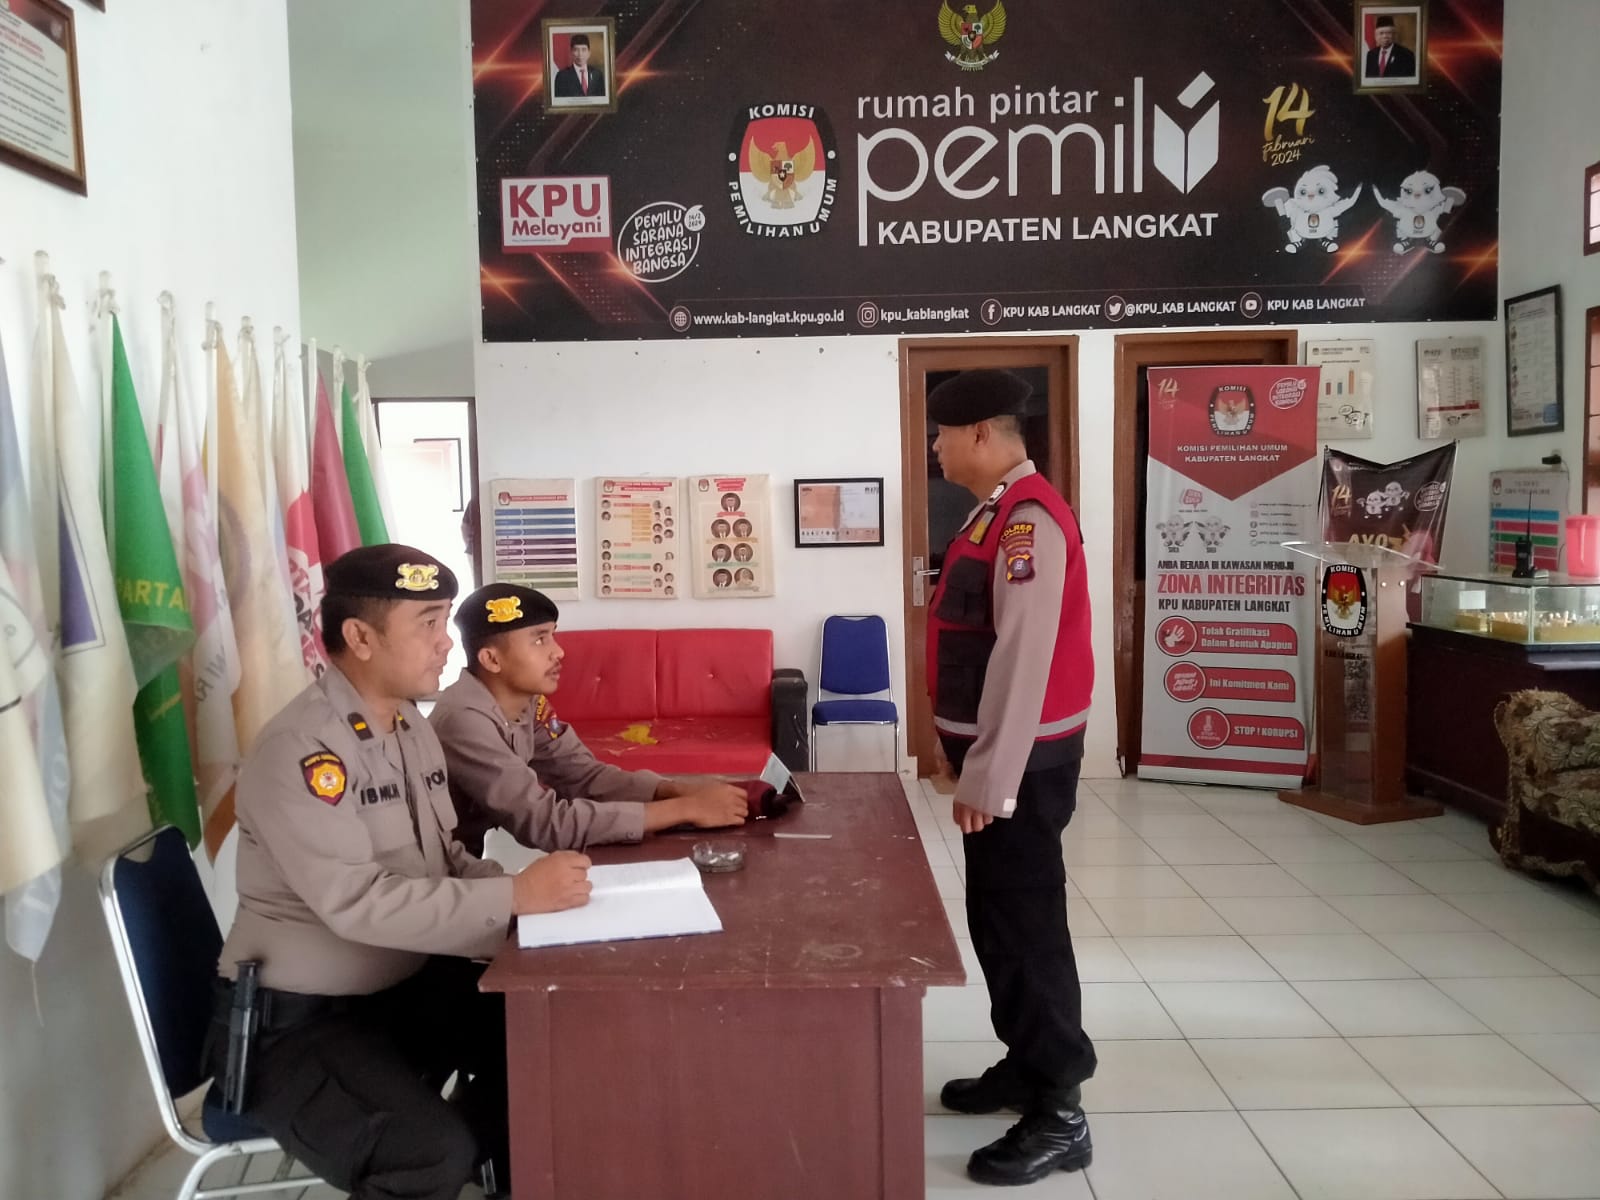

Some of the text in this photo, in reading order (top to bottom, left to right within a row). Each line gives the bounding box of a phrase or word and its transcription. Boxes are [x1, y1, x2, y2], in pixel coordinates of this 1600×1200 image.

[749, 104, 815, 120] KOMISI
[857, 85, 1099, 124] rumah pintar
[1262, 83, 1316, 141] 14
[1271, 149, 1301, 167] 2024
[509, 184, 601, 218] KPU
[728, 179, 838, 237] PEMILIHAN UMUM
[512, 216, 602, 240] Melayani
[634, 209, 682, 231] PEMILU
[633, 222, 684, 245] SARANA
[878, 213, 1219, 245] KABUPATEN LANGKAT
[625, 236, 692, 262] INTEGRASI
[633, 252, 686, 275] BANGSA
[1003, 304, 1101, 318] KPU KAB LANGKAT
[1124, 301, 1237, 316] @KPU_KAB LANGKAT
[1267, 298, 1366, 311] KPU KAB LANGKAT
[693, 309, 845, 326] www.kab-langkat.kpu.go.id
[880, 307, 970, 323] kpu_kablangkat
[1210, 444, 1258, 452] PEMILIHAN
[1239, 454, 1280, 462] LANGKAT
[1221, 560, 1261, 570] KAWASAN
[1330, 565, 1357, 574] KOMISI
[1157, 574, 1305, 596] ZONA INTEGRITAS
[1158, 599, 1291, 612] KPU KABUPATEN LANGKAT
[1201, 626, 1224, 635] Tolak
[1210, 679, 1221, 687] Ini
[1222, 679, 1266, 689] Komitmen
[1234, 726, 1255, 735] STOP
[1261, 727, 1298, 738] KORUPSI
